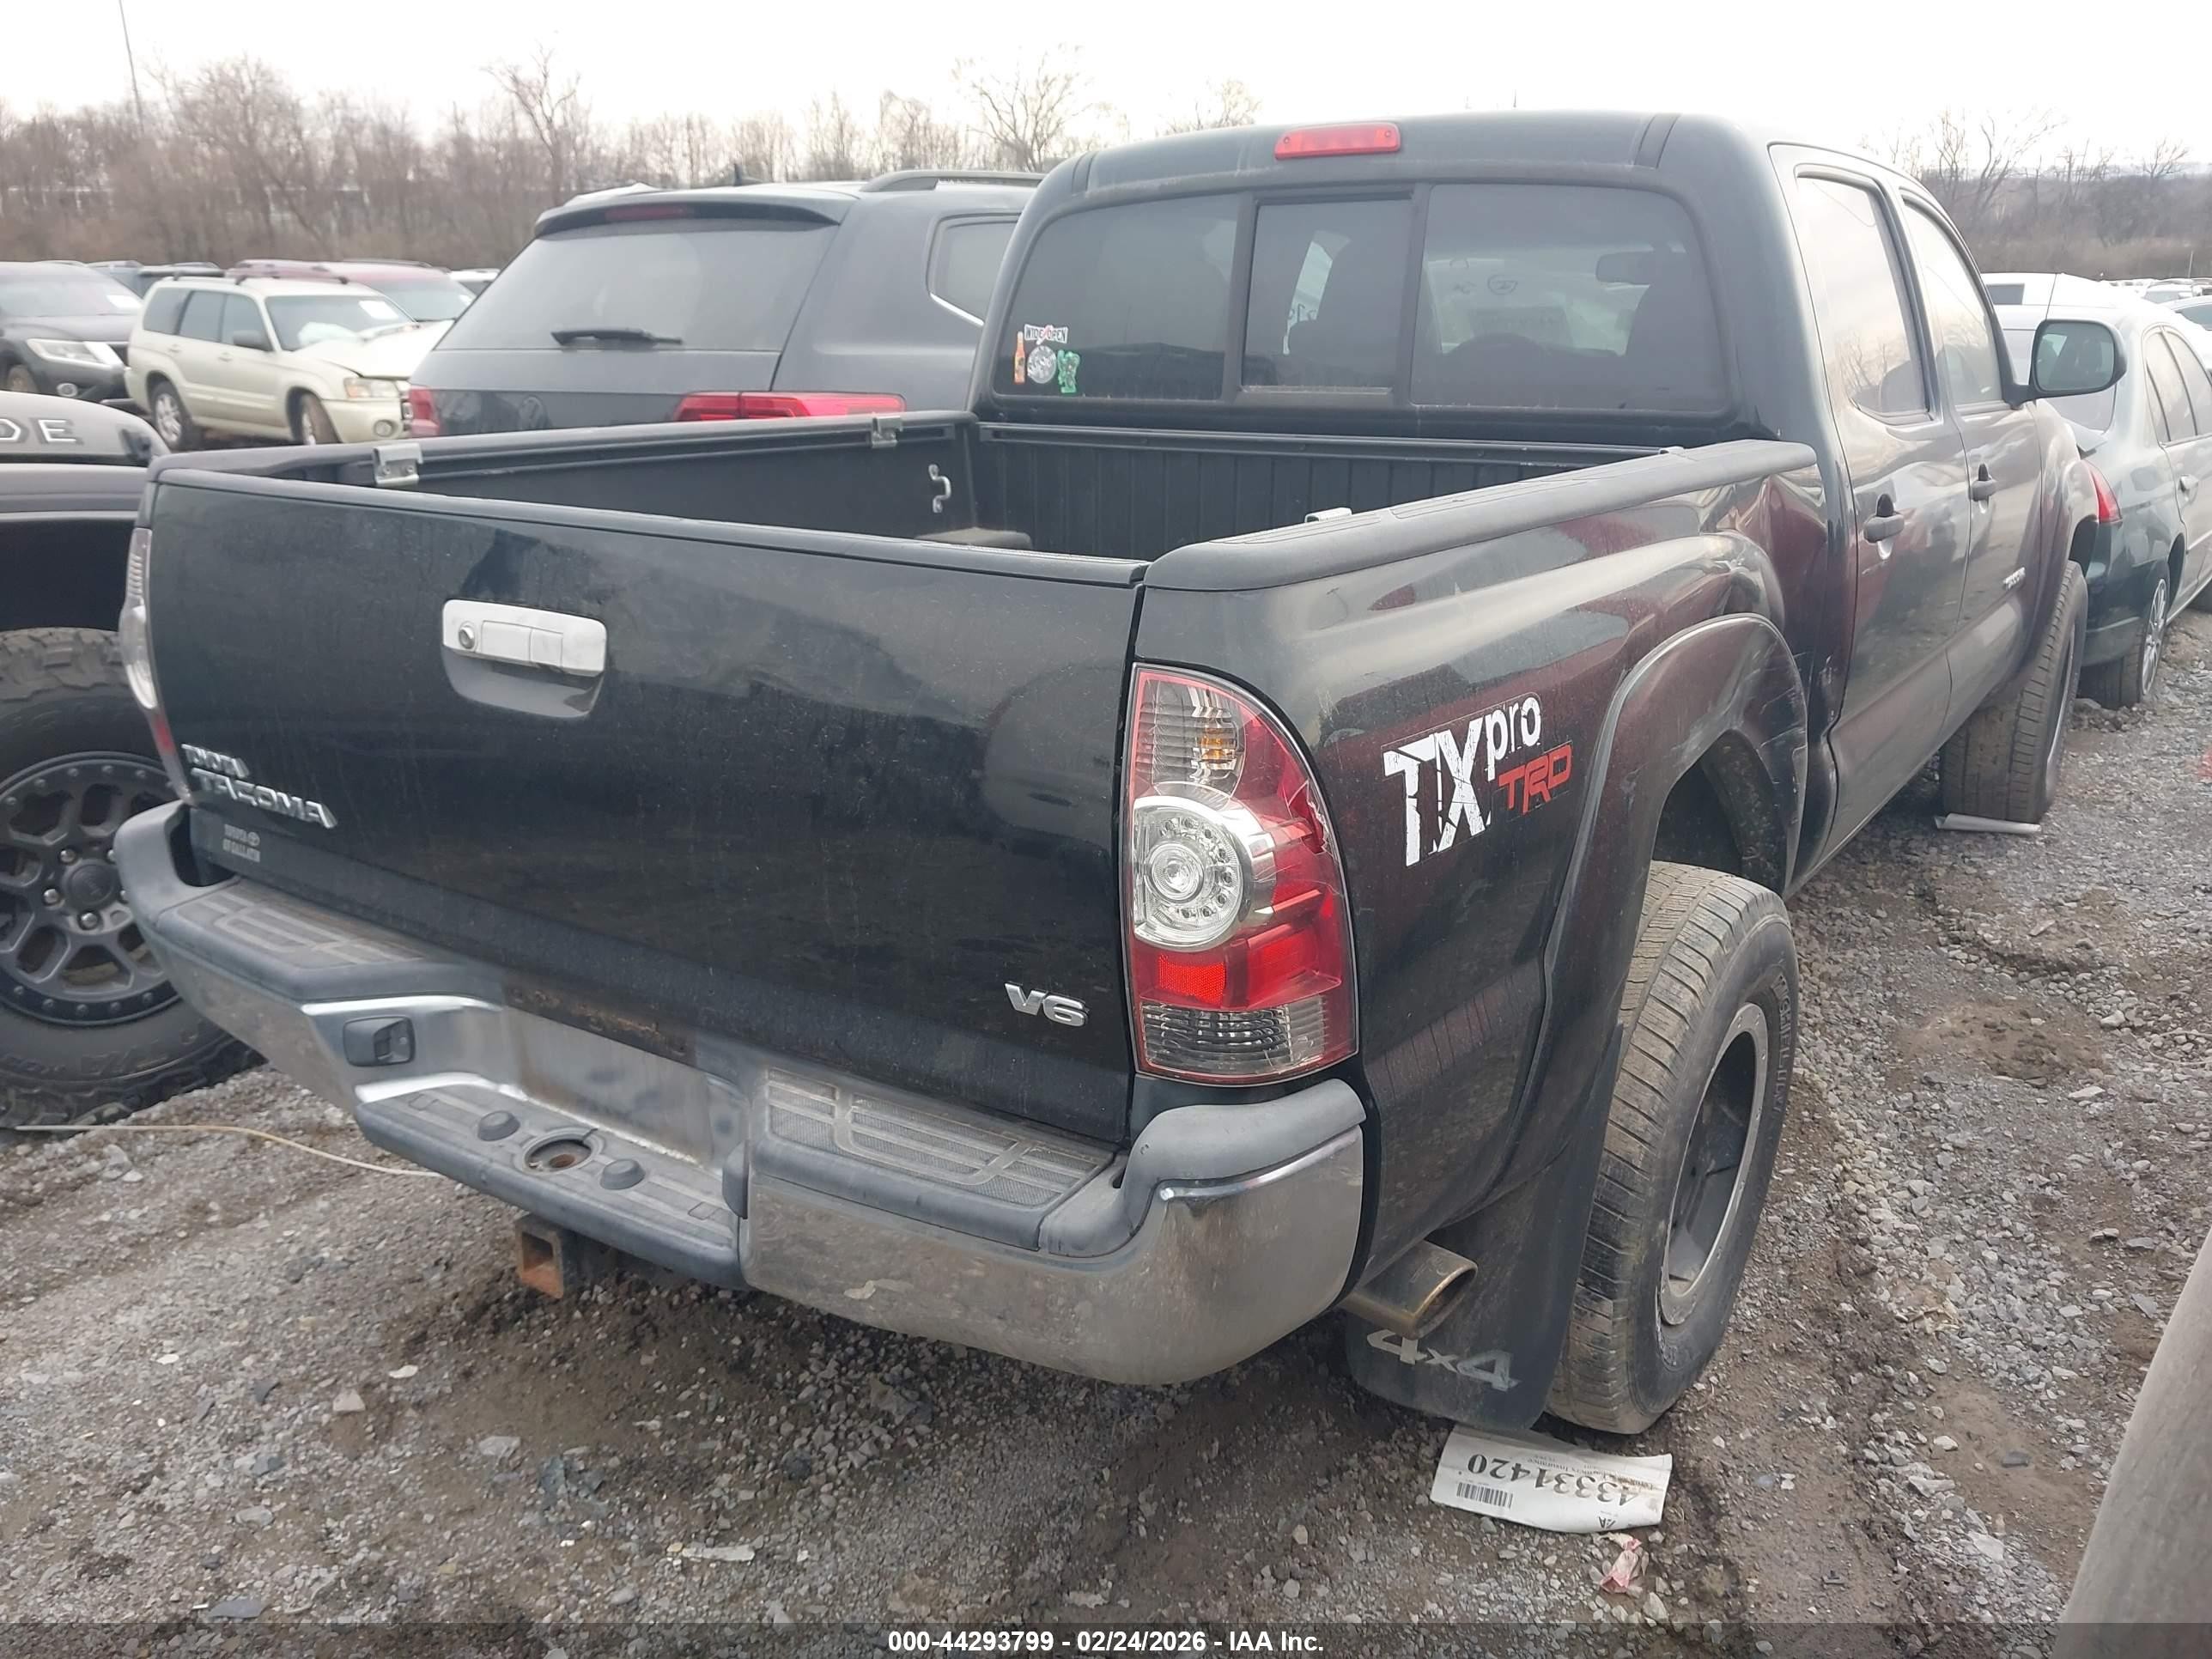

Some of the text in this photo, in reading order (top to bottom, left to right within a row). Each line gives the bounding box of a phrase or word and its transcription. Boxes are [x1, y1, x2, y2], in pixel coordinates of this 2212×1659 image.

[1485, 697, 1541, 781] pro
[191, 767, 337, 829] TACOMA
[1498, 744, 1573, 815] TRD
[1005, 983, 1089, 1027] V6
[1467, 1453, 1640, 1507] 43331420
